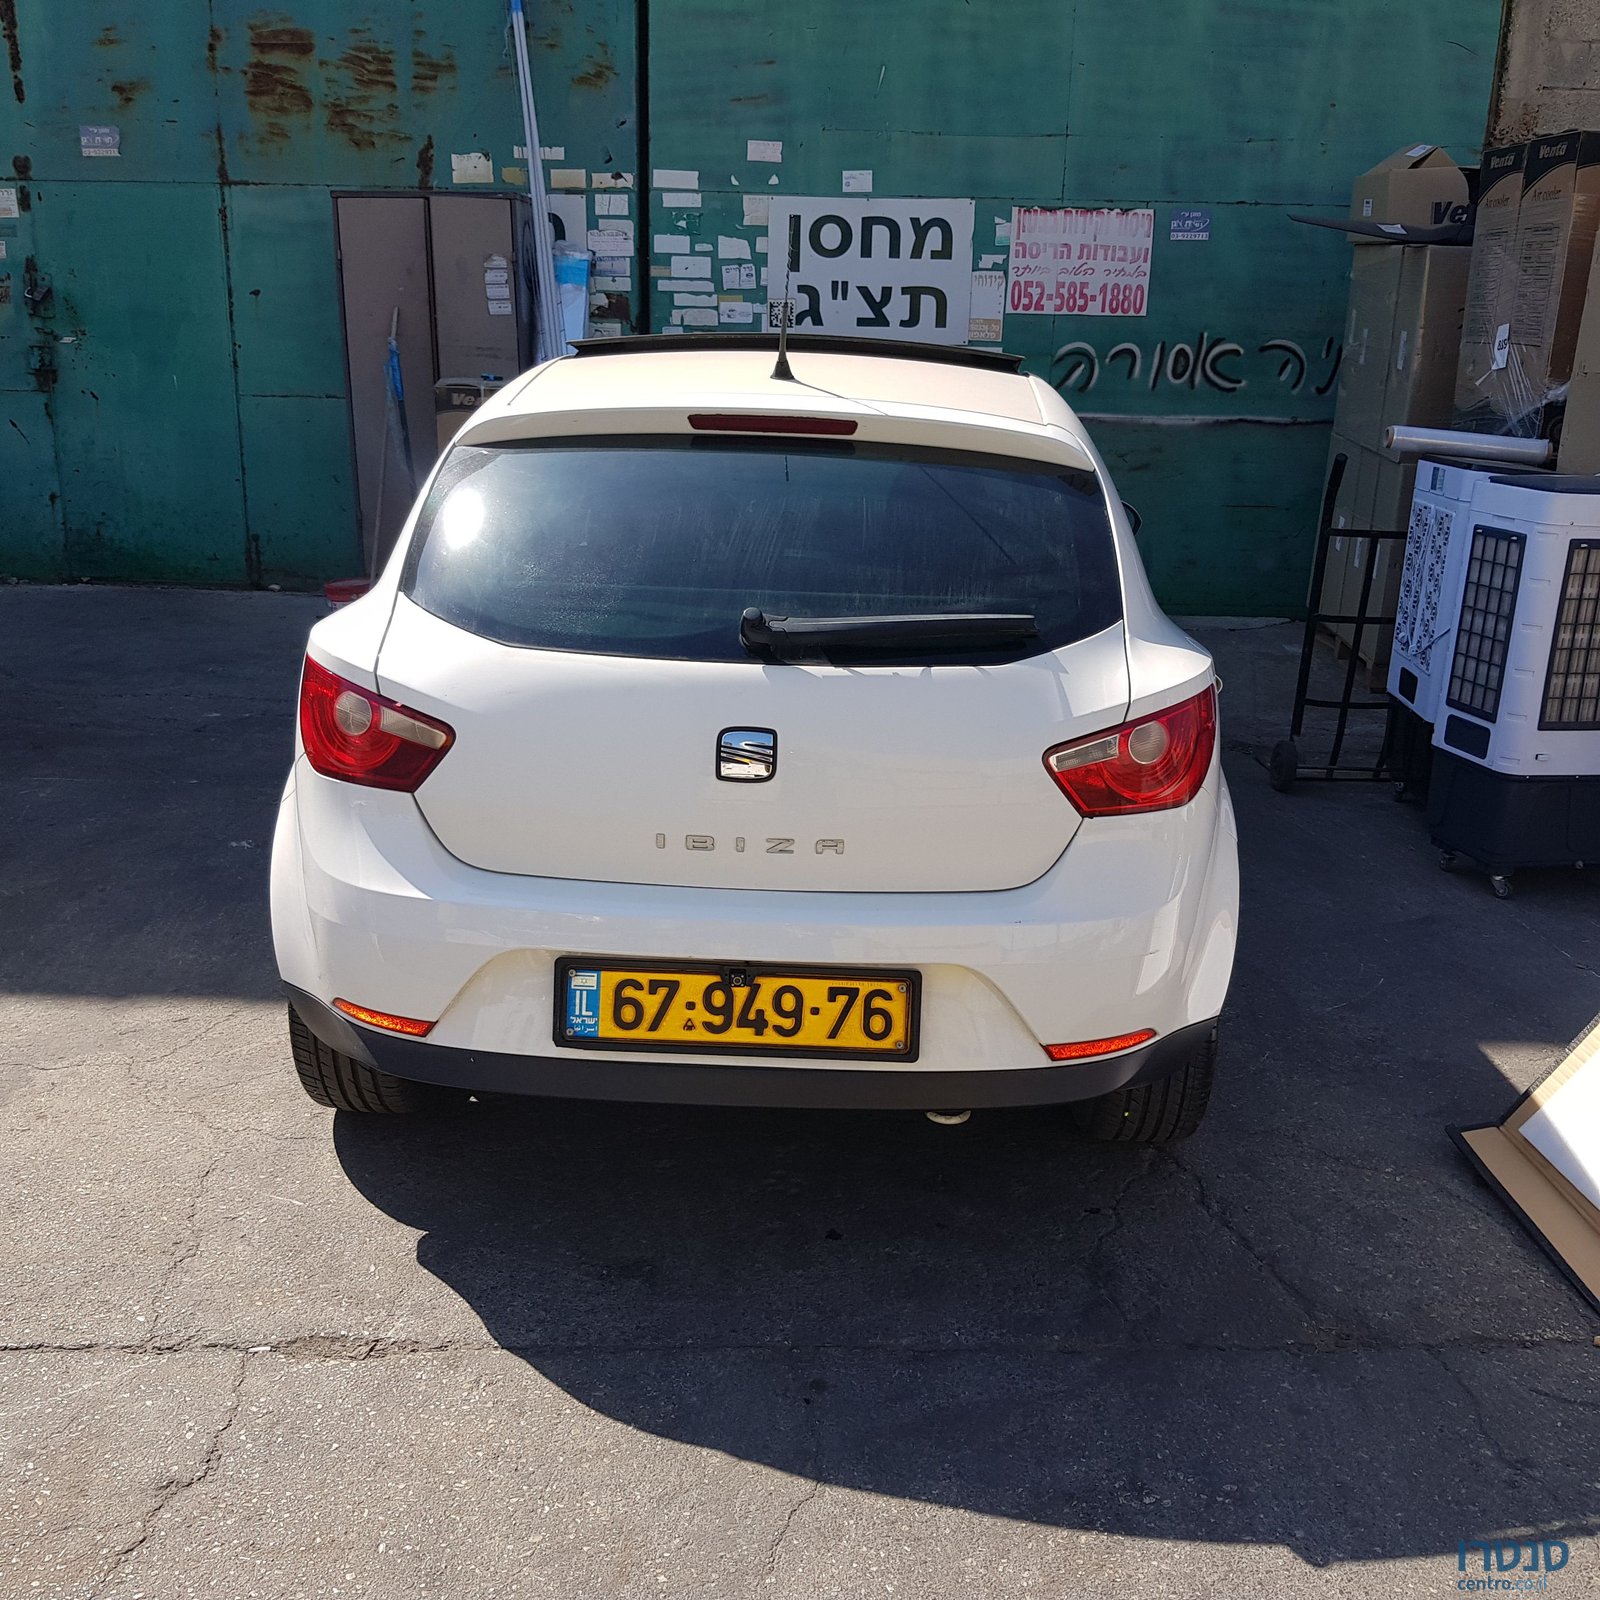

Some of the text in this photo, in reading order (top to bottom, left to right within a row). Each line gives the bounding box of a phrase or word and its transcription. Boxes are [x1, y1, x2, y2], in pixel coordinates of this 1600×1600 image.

[1489, 153, 1516, 169] Venta
[1538, 142, 1568, 159] Venta
[788, 214, 954, 273] מחסן
[1014, 242, 1150, 264] ועבודות הריסה
[1011, 264, 1052, 277] ביותר
[1058, 262, 1096, 277] הטוב
[795, 280, 948, 328] תצ"ג
[1010, 280, 1145, 314] 052-585-1880
[1053, 332, 1344, 395] ניה אסורה
[655, 833, 845, 854] IBIZA
[575, 990, 593, 1015] IL
[570, 1016, 598, 1025] ישראל
